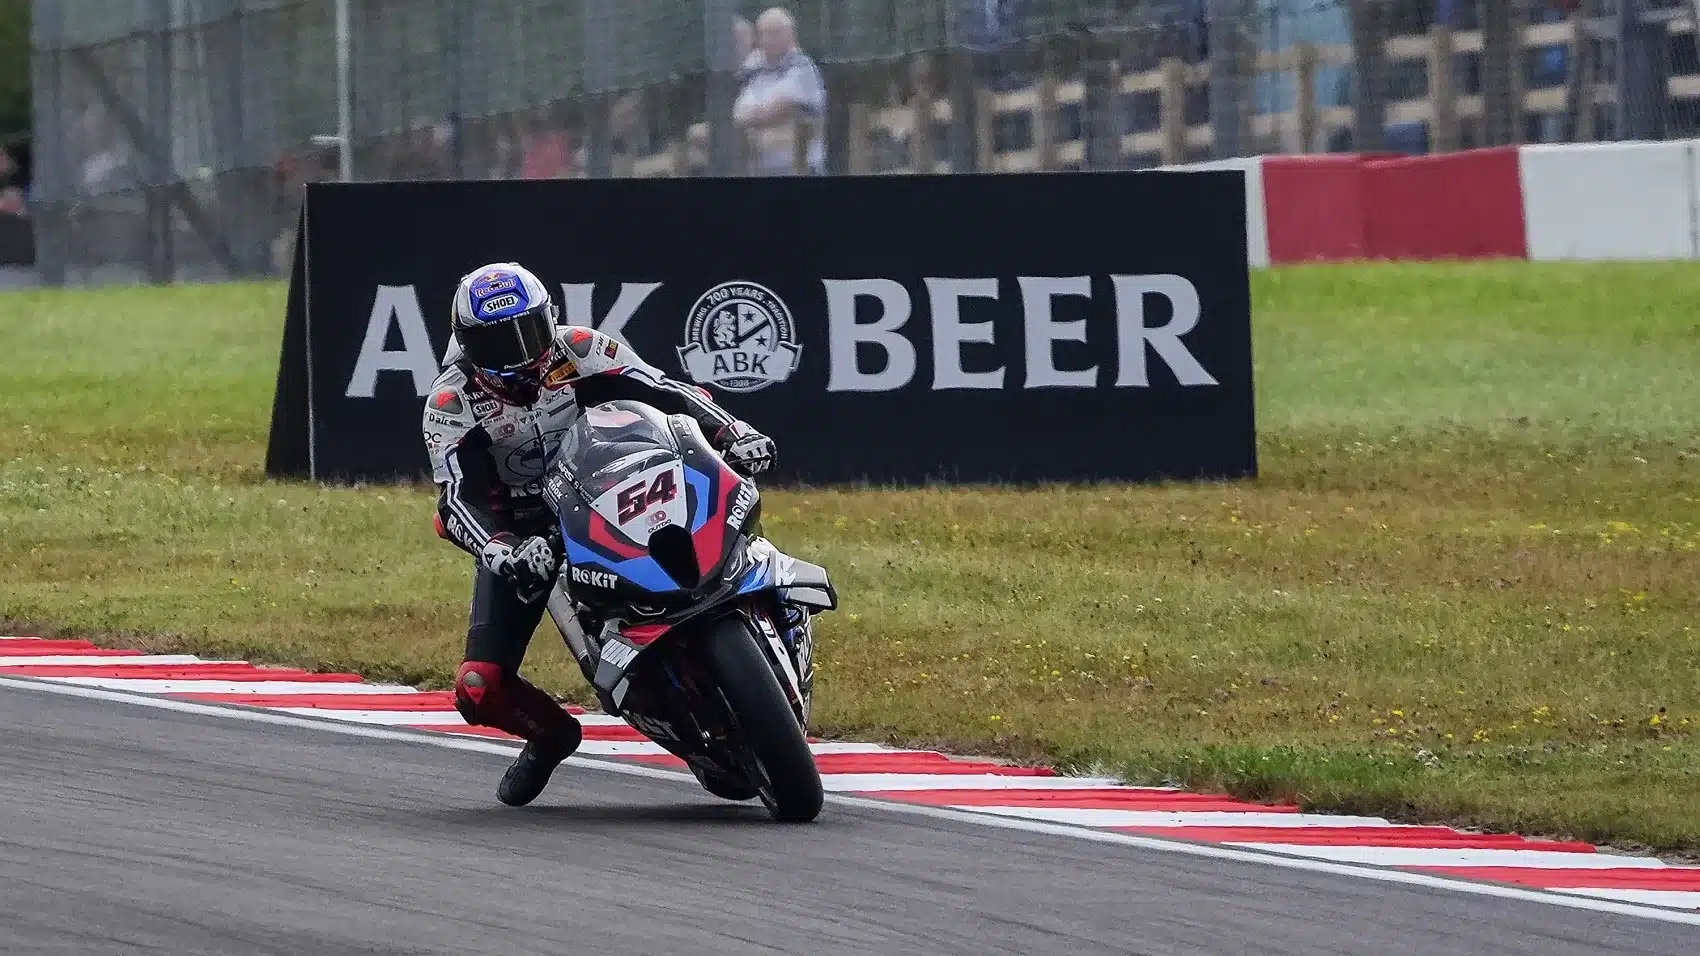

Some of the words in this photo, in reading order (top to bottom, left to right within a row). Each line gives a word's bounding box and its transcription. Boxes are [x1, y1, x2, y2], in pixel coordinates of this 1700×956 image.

[486, 296, 516, 312] SHOEI
[497, 279, 517, 291] Bull
[691, 307, 708, 341] BREWING
[707, 288, 729, 304] 700
[729, 287, 764, 301] YEARS
[766, 301, 789, 339] TRADITION
[821, 273, 1220, 392] BEER
[344, 281, 664, 399] AK
[712, 351, 771, 376] ABK
[475, 401, 498, 413] SHOEI
[616, 468, 678, 527] 54
